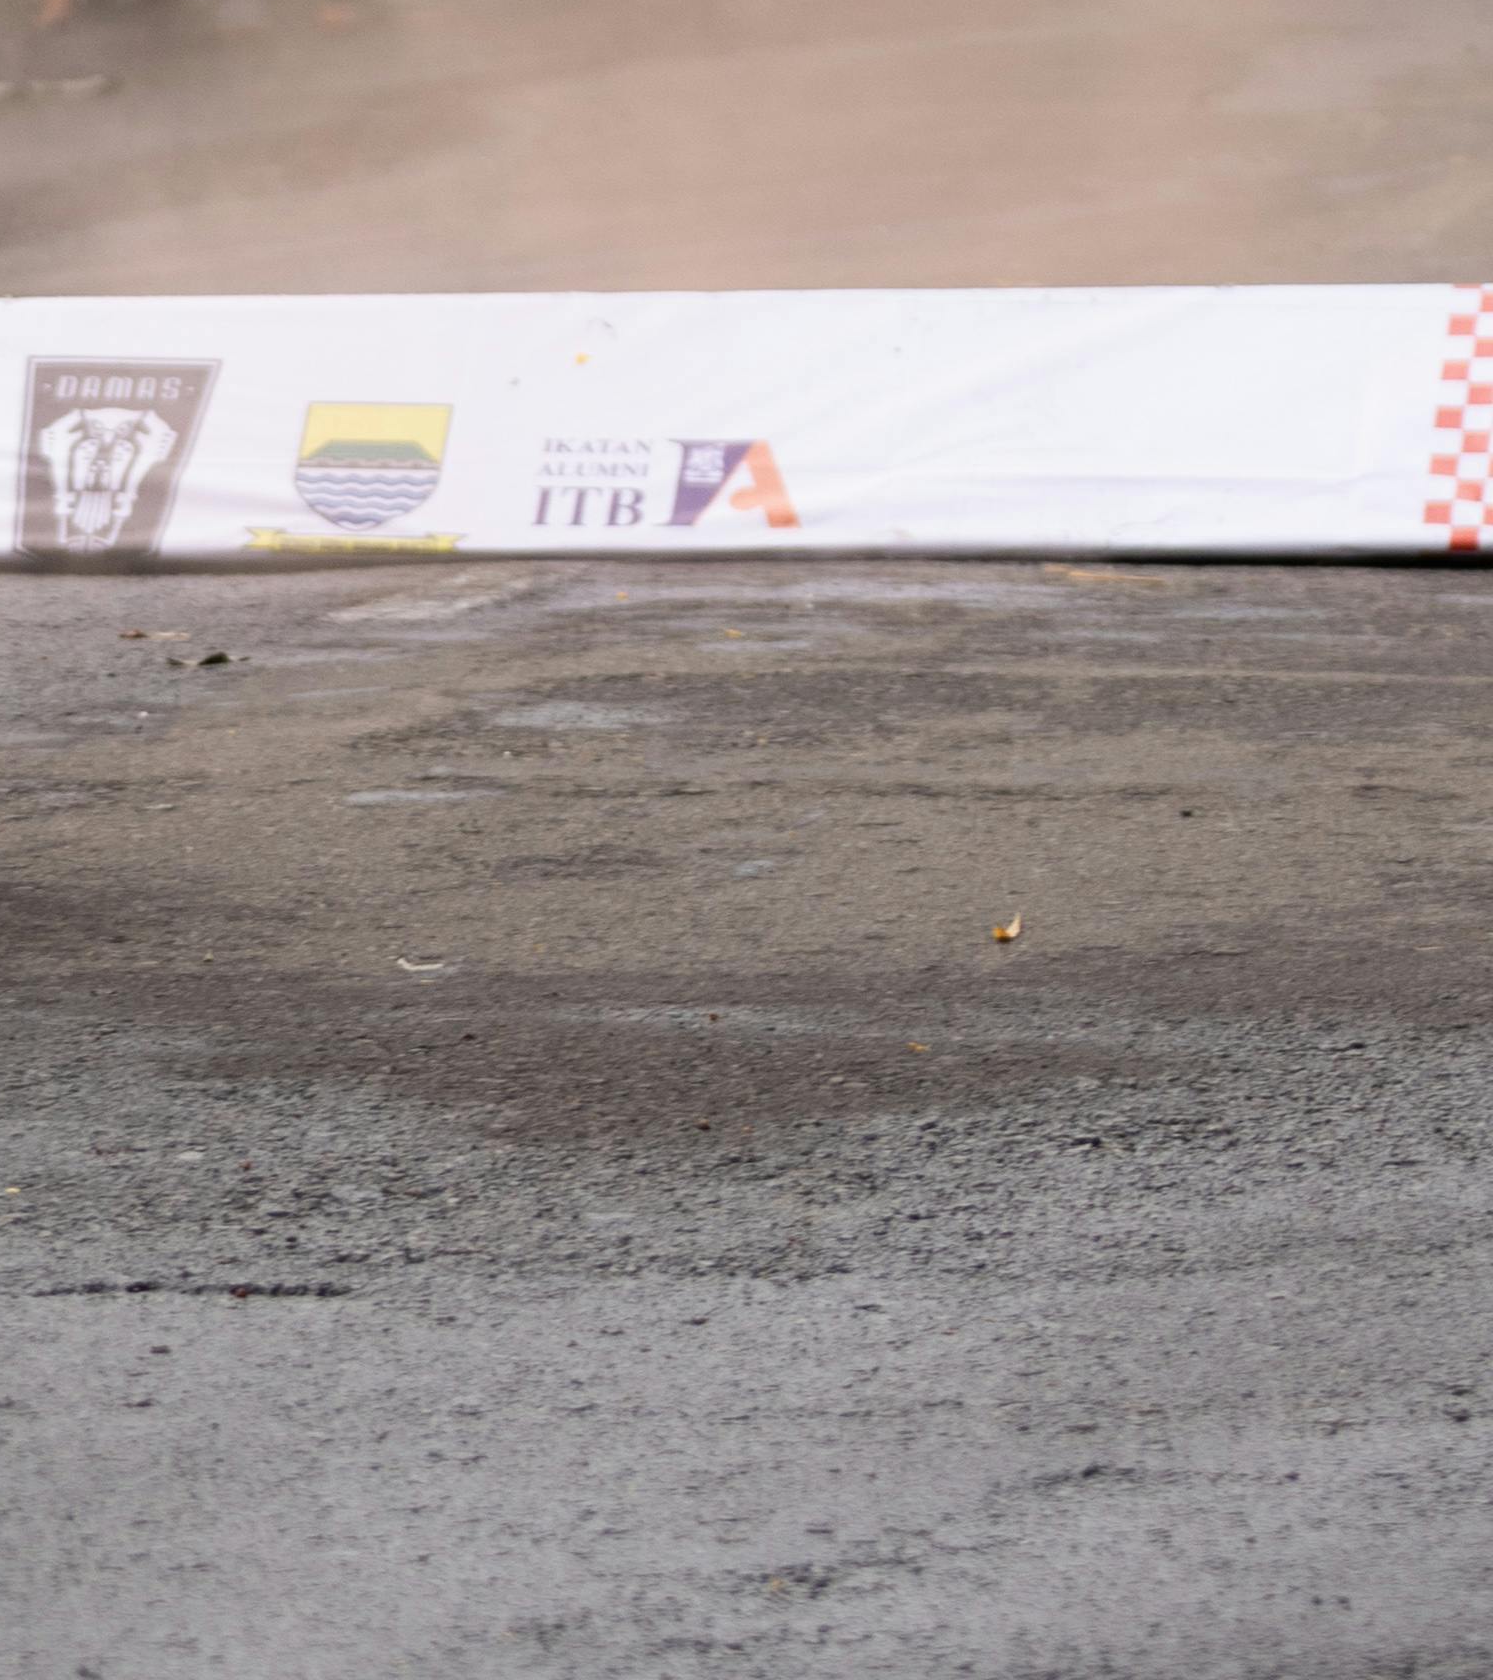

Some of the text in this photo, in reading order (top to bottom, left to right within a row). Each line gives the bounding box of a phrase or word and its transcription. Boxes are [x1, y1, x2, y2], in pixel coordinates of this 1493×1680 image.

[55, 374, 183, 400] DAMAS
[541, 438, 654, 454] IKATAN
[537, 462, 650, 478] ALUMNI
[531, 485, 646, 527] ITB
